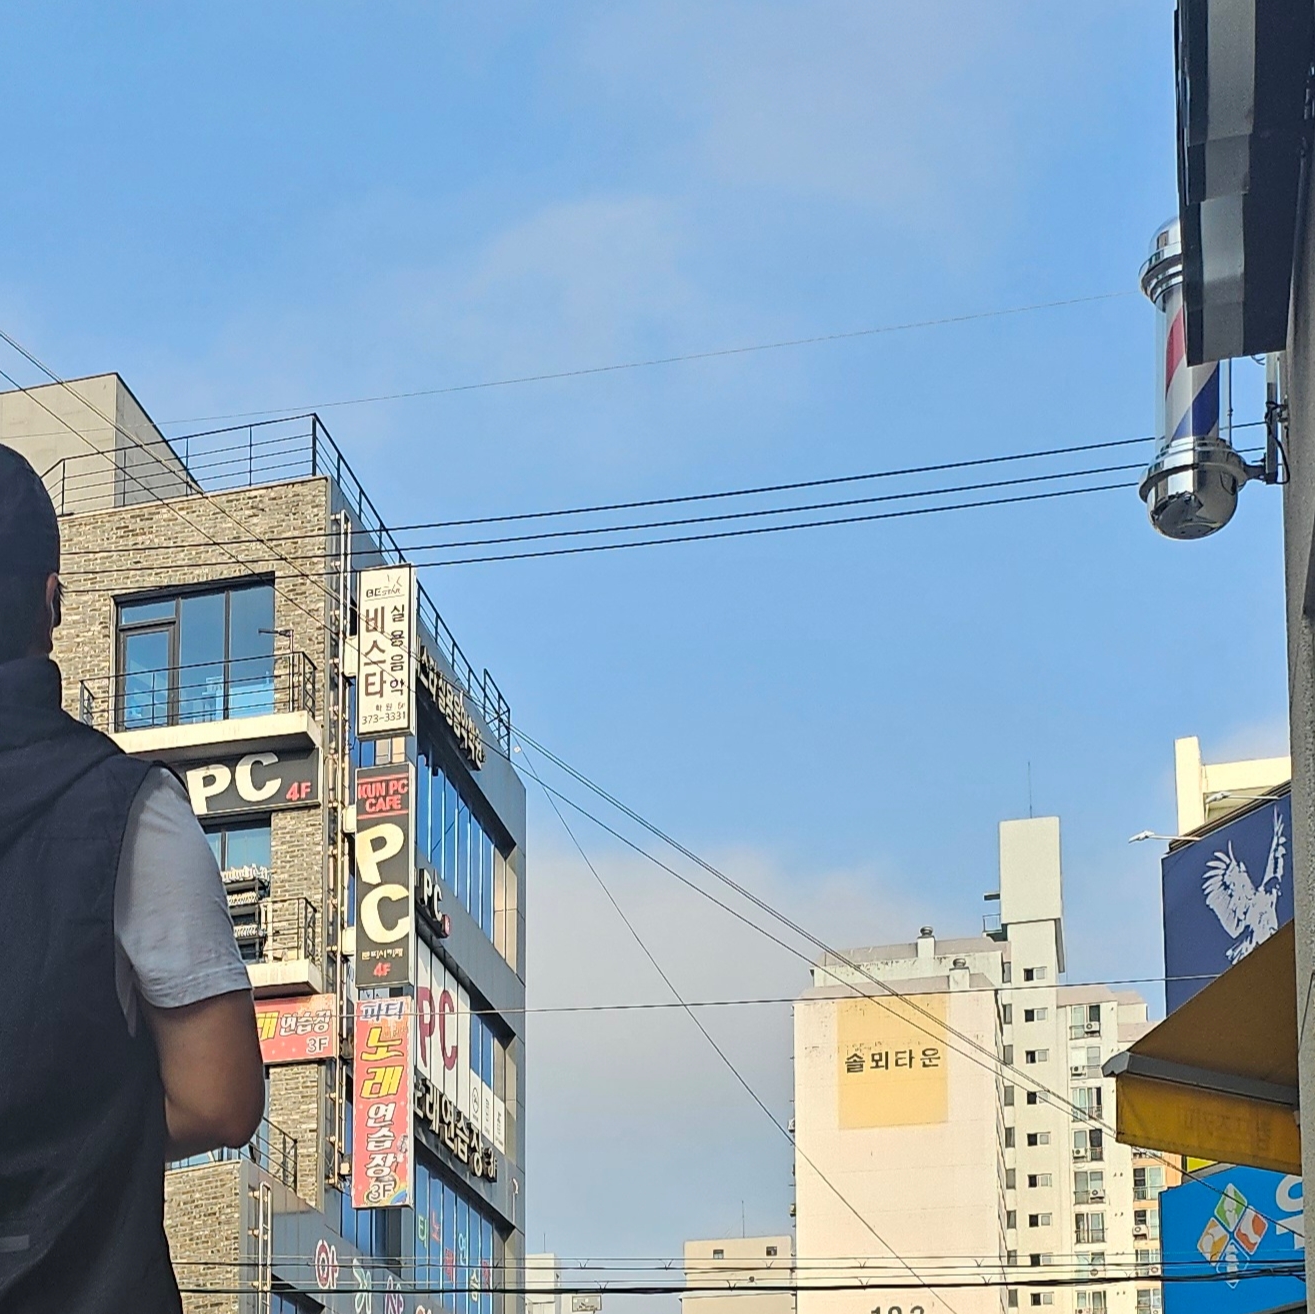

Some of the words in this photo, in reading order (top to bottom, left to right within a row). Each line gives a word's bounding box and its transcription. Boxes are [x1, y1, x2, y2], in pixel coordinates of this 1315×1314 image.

[364, 606, 387, 698] 비스타
[390, 604, 406, 696] 실용음악
[361, 710, 407, 726] 373-3331
[185, 751, 282, 815] PC
[286, 781, 312, 801] 4F
[357, 782, 386, 799] KUN
[389, 779, 409, 795] PC
[365, 794, 402, 813] CAFE
[355, 822, 410, 944] PC
[373, 962, 391, 977] 4F
[279, 1009, 332, 1037] 연습장
[360, 1001, 404, 1022] 파티
[416, 986, 458, 1072] PC
[306, 1035, 329, 1054] 3F
[844, 1047, 942, 1073] 솔뫼타운
[365, 1102, 398, 1179] 연습장
[368, 1180, 397, 1204] 3F
